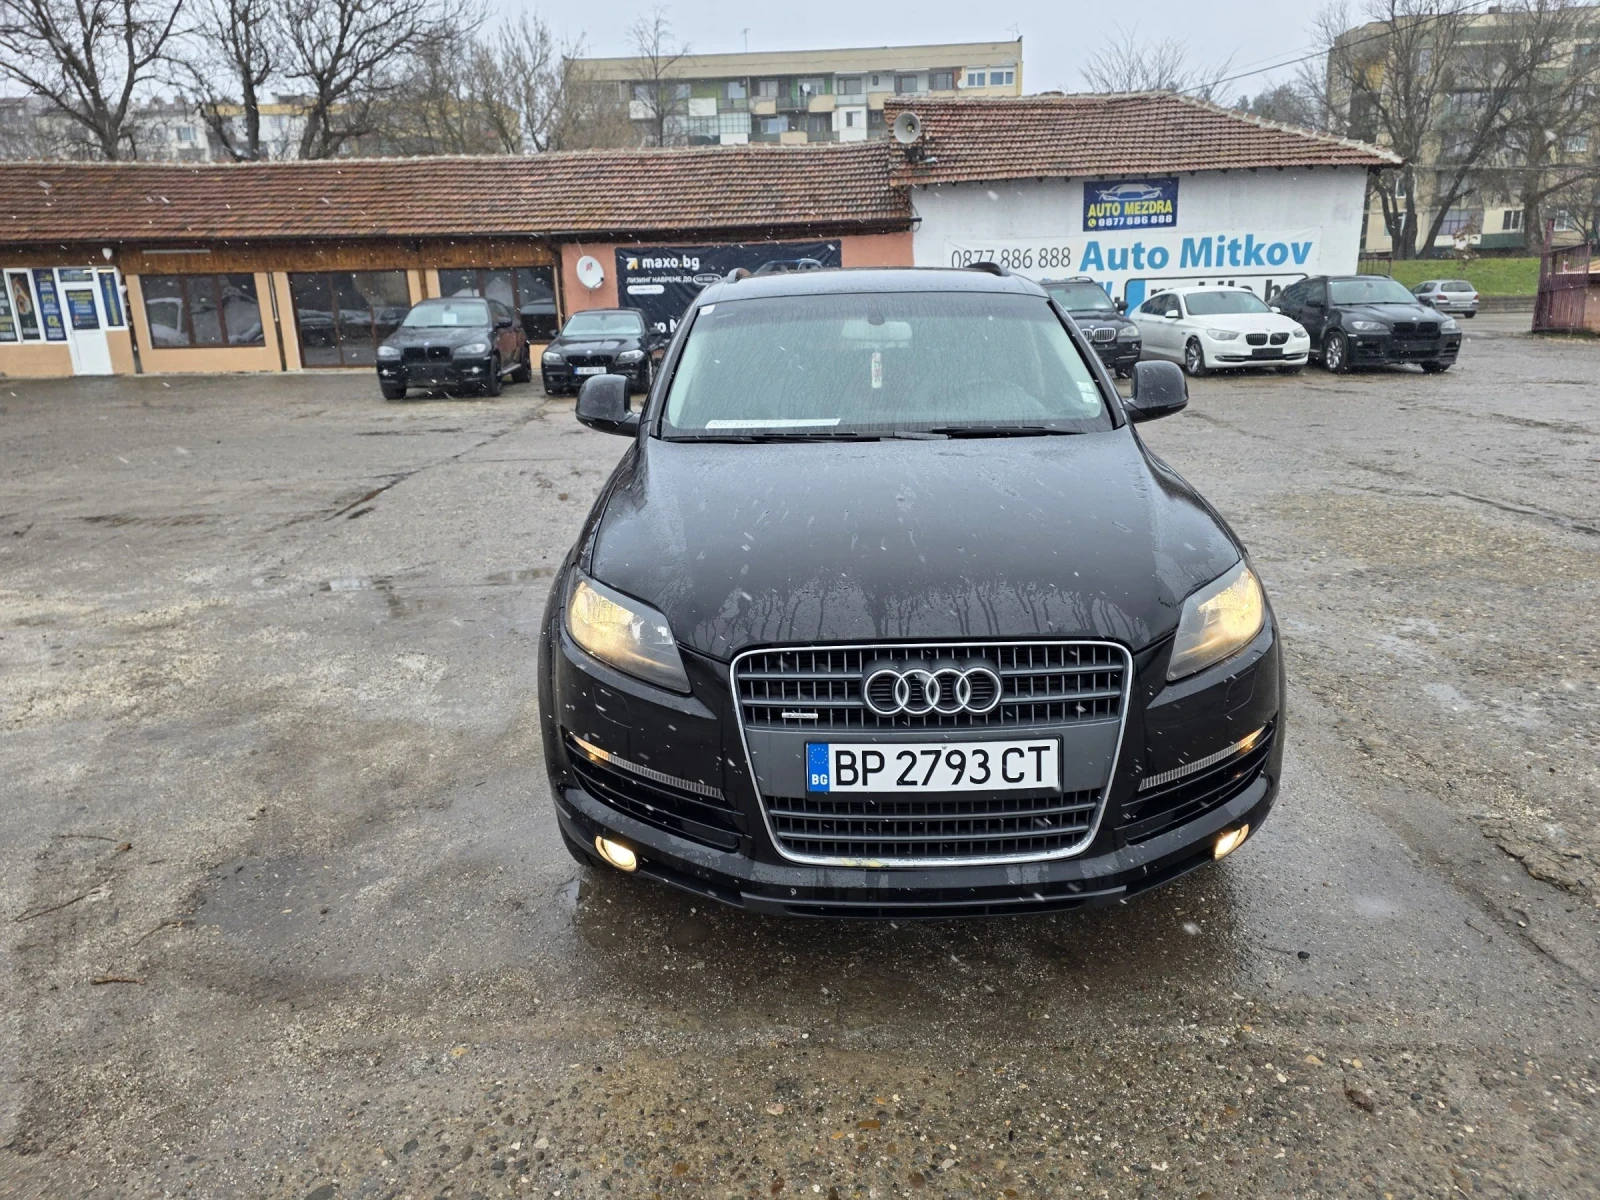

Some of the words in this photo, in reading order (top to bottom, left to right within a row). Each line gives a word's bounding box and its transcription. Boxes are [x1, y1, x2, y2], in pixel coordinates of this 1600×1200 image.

[1088, 202, 1121, 217] AUTO
[1124, 200, 1173, 215] MEZDRA
[1098, 217, 1125, 227] 0877
[1126, 216, 1148, 225] 886
[1150, 214, 1173, 223] 888
[951, 249, 995, 268] 0877
[1000, 248, 1033, 269] 886
[1038, 247, 1071, 268] 888
[1079, 240, 1170, 272] Auto
[1179, 234, 1313, 269] Mitkov
[642, 254, 700, 271] maxo.bg
[626, 276, 652, 285] ЛИЗИНГ
[835, 749, 886, 787] BP
[896, 748, 991, 787] 2793
[1001, 745, 1051, 784] CT
[811, 773, 828, 786] BG
